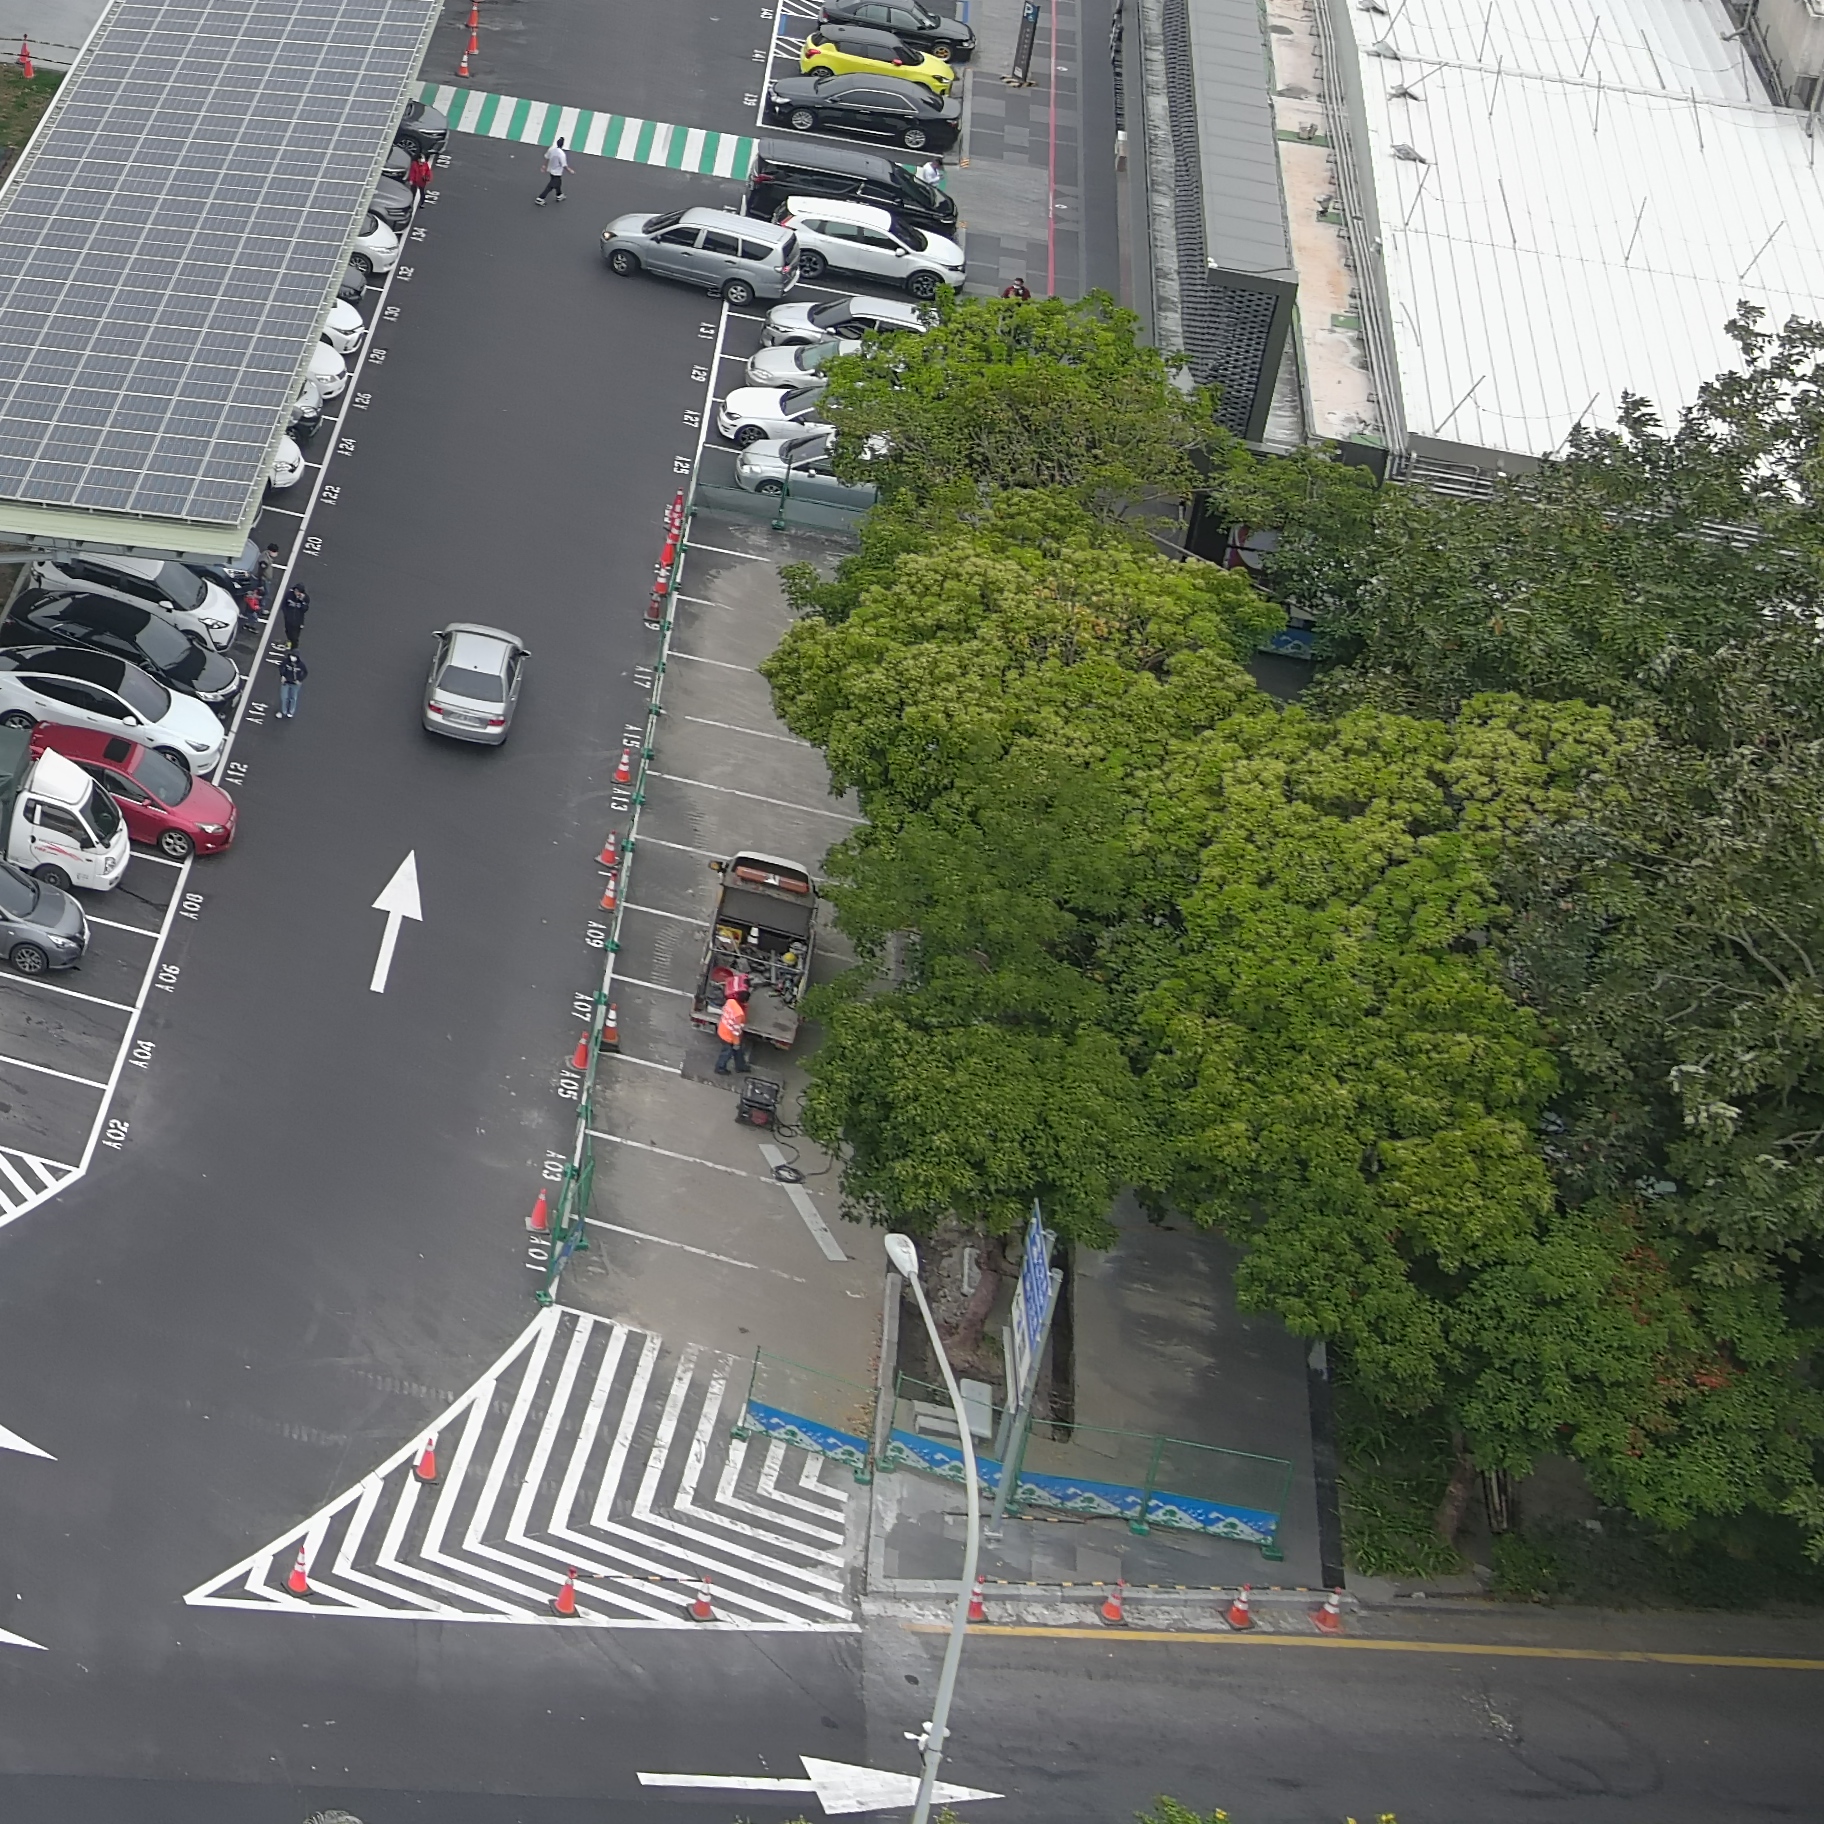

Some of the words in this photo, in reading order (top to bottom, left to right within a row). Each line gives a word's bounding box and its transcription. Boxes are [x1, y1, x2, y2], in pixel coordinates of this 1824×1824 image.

[352, 392, 372, 410] A26
[337, 438, 356, 456] A24
[320, 485, 341, 505] A22
[303, 536, 323, 556] A20
[265, 642, 286, 665] A16
[633, 665, 652, 689] A17
[245, 701, 268, 724] A14
[623, 724, 643, 748] A15
[225, 761, 249, 785] A12
[610, 788, 631, 811] A13
[179, 893, 203, 920] A08
[585, 921, 606, 947] A09
[155, 965, 181, 993] A06
[571, 992, 593, 1022] A07
[128, 1039, 156, 1069] A04
[558, 1069, 578, 1100] A05
[102, 1118, 130, 1150] A02
[542, 1150, 567, 1181] A03
